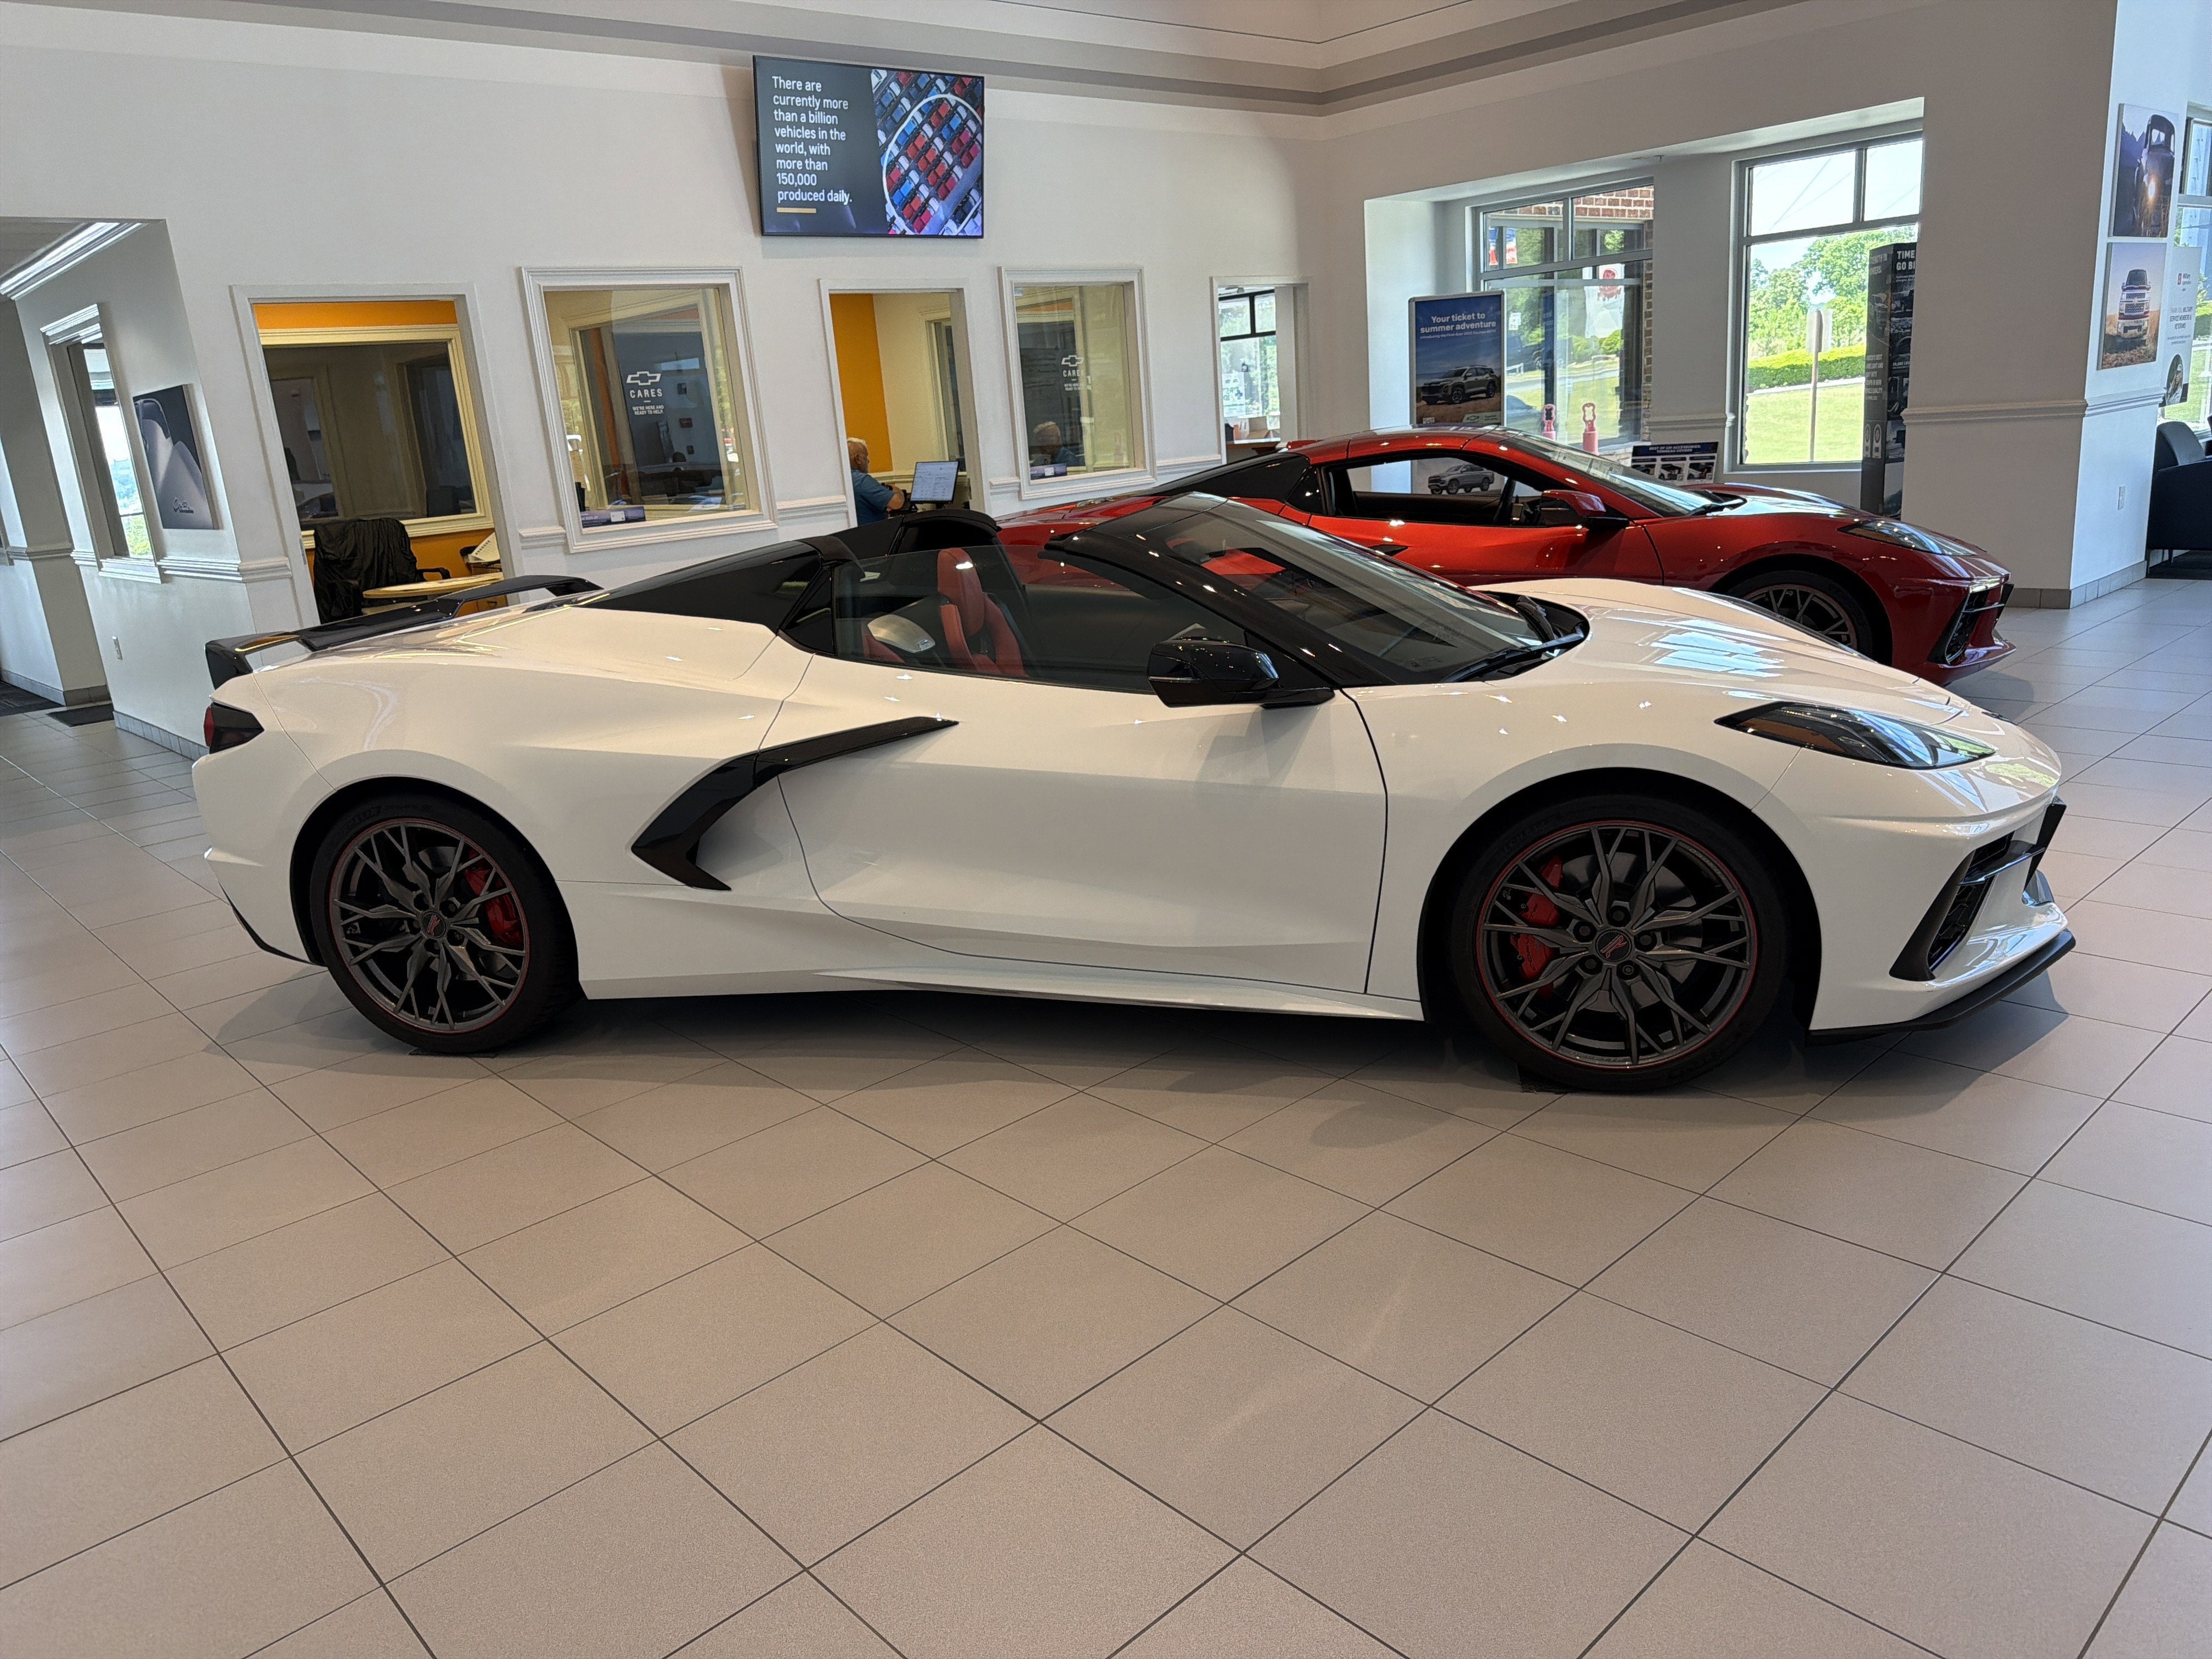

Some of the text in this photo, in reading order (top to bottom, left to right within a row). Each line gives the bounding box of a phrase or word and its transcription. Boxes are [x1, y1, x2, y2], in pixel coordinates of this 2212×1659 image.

[772, 76, 822, 92] There are
[773, 94, 849, 110] currently more
[774, 108, 838, 125] than a billion
[774, 125, 846, 141] vehicles in the
[775, 141, 831, 156] world, with
[776, 158, 828, 171] more than
[776, 172, 817, 187] 150,000
[777, 189, 853, 205] produced daily.
[1897, 250, 1915, 259] TIME
[1896, 262, 1906, 271] GO
[1452, 313, 1475, 321] ticket
[1420, 321, 1497, 333] summer adventure
[630, 388, 663, 398] CARES
